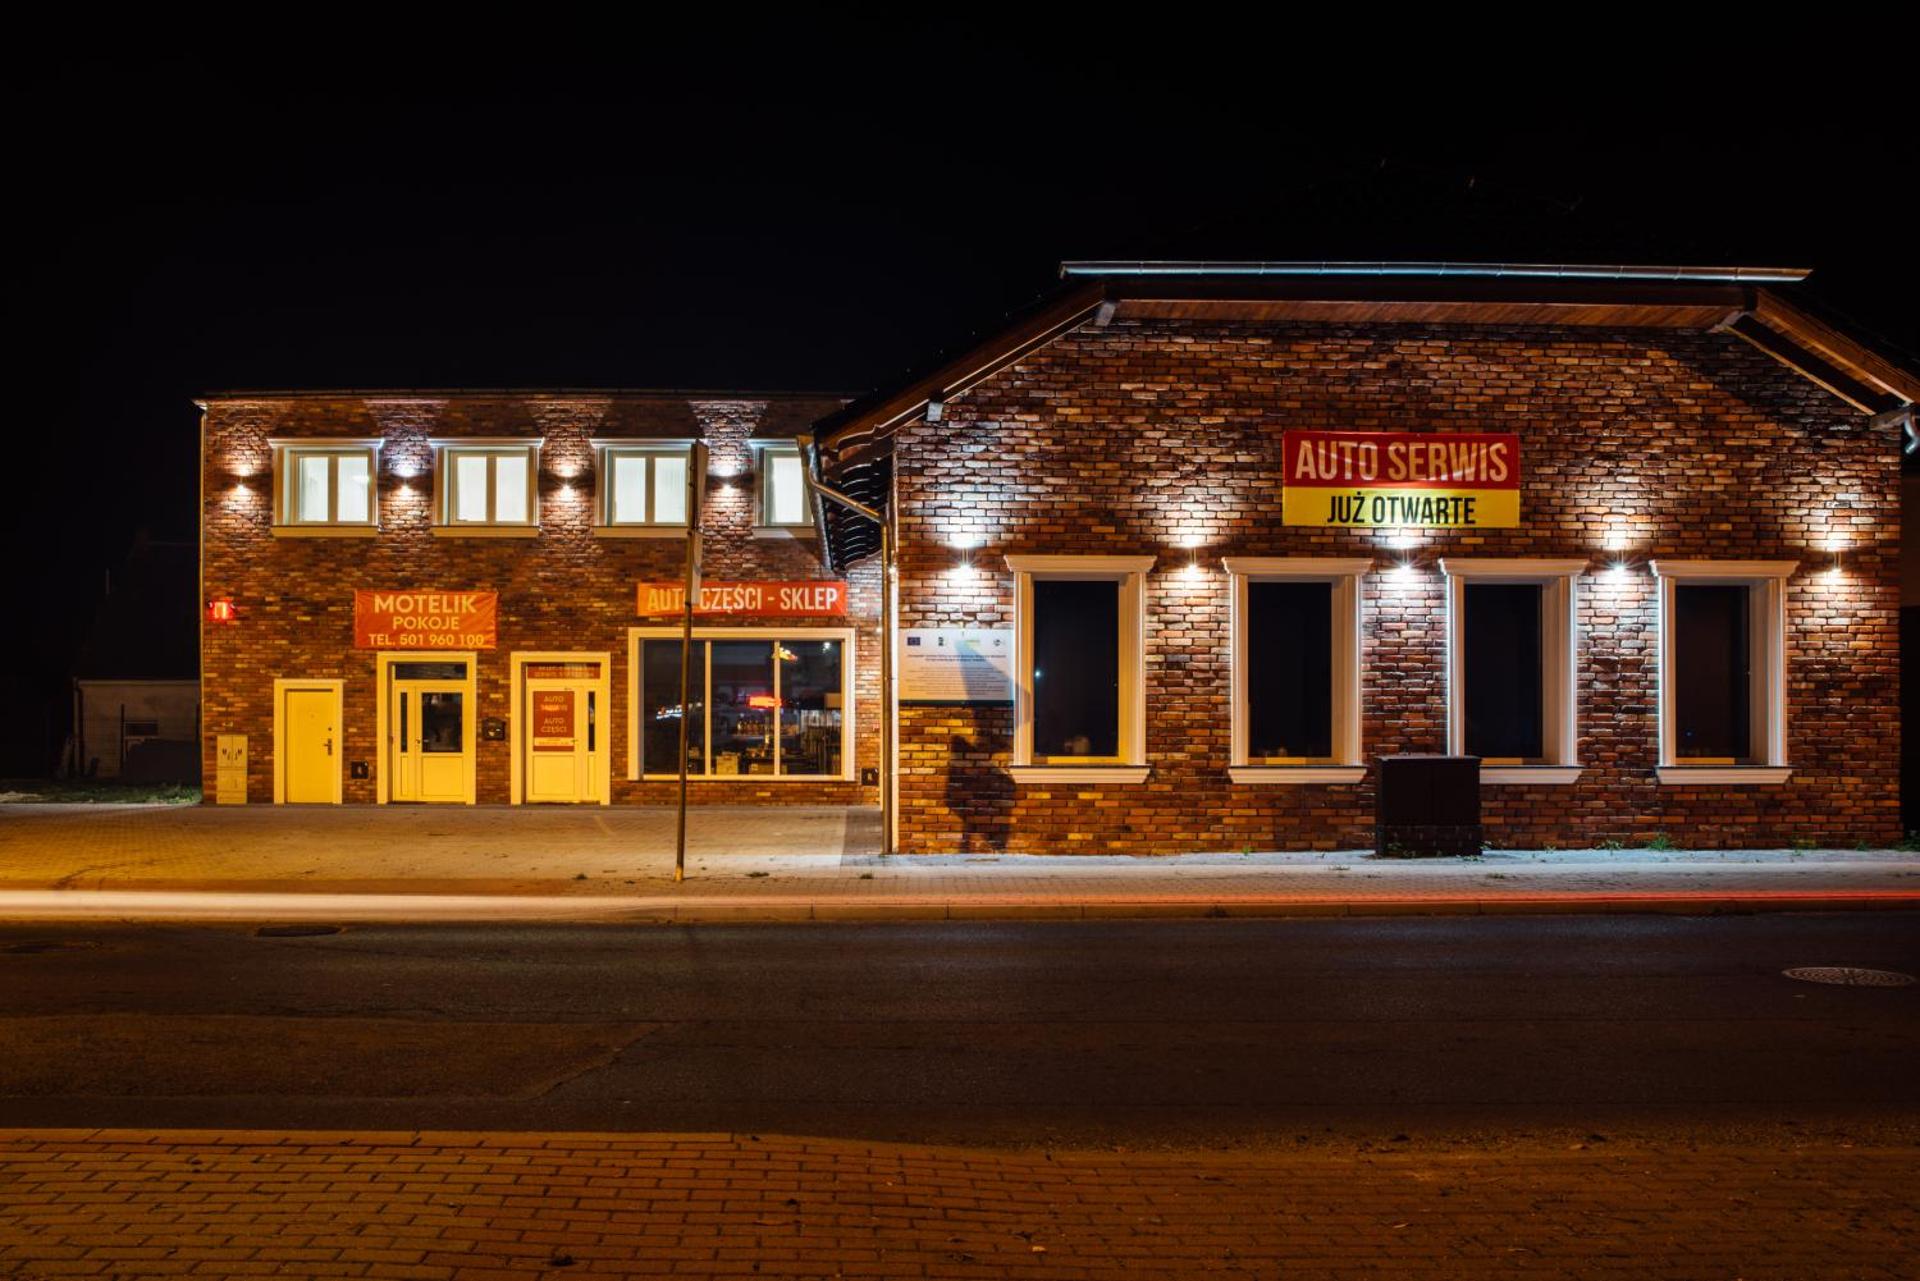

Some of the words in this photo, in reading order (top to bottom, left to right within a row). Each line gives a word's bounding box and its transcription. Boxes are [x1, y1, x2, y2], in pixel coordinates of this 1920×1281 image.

[1295, 439, 1378, 481] AUTO
[1387, 441, 1508, 482] SERWIS
[1327, 491, 1365, 523] JUŻ
[1372, 496, 1476, 524] OTWARTE
[374, 594, 477, 613] MOTELIK
[648, 588, 685, 610] AUT
[700, 583, 762, 614] CZĘŚCI
[780, 587, 838, 610] SKLEP
[392, 616, 460, 630] POKOJE
[368, 633, 396, 645] TEL.
[400, 634, 424, 646] 501
[429, 634, 455, 646] 960
[459, 634, 485, 646] 100
